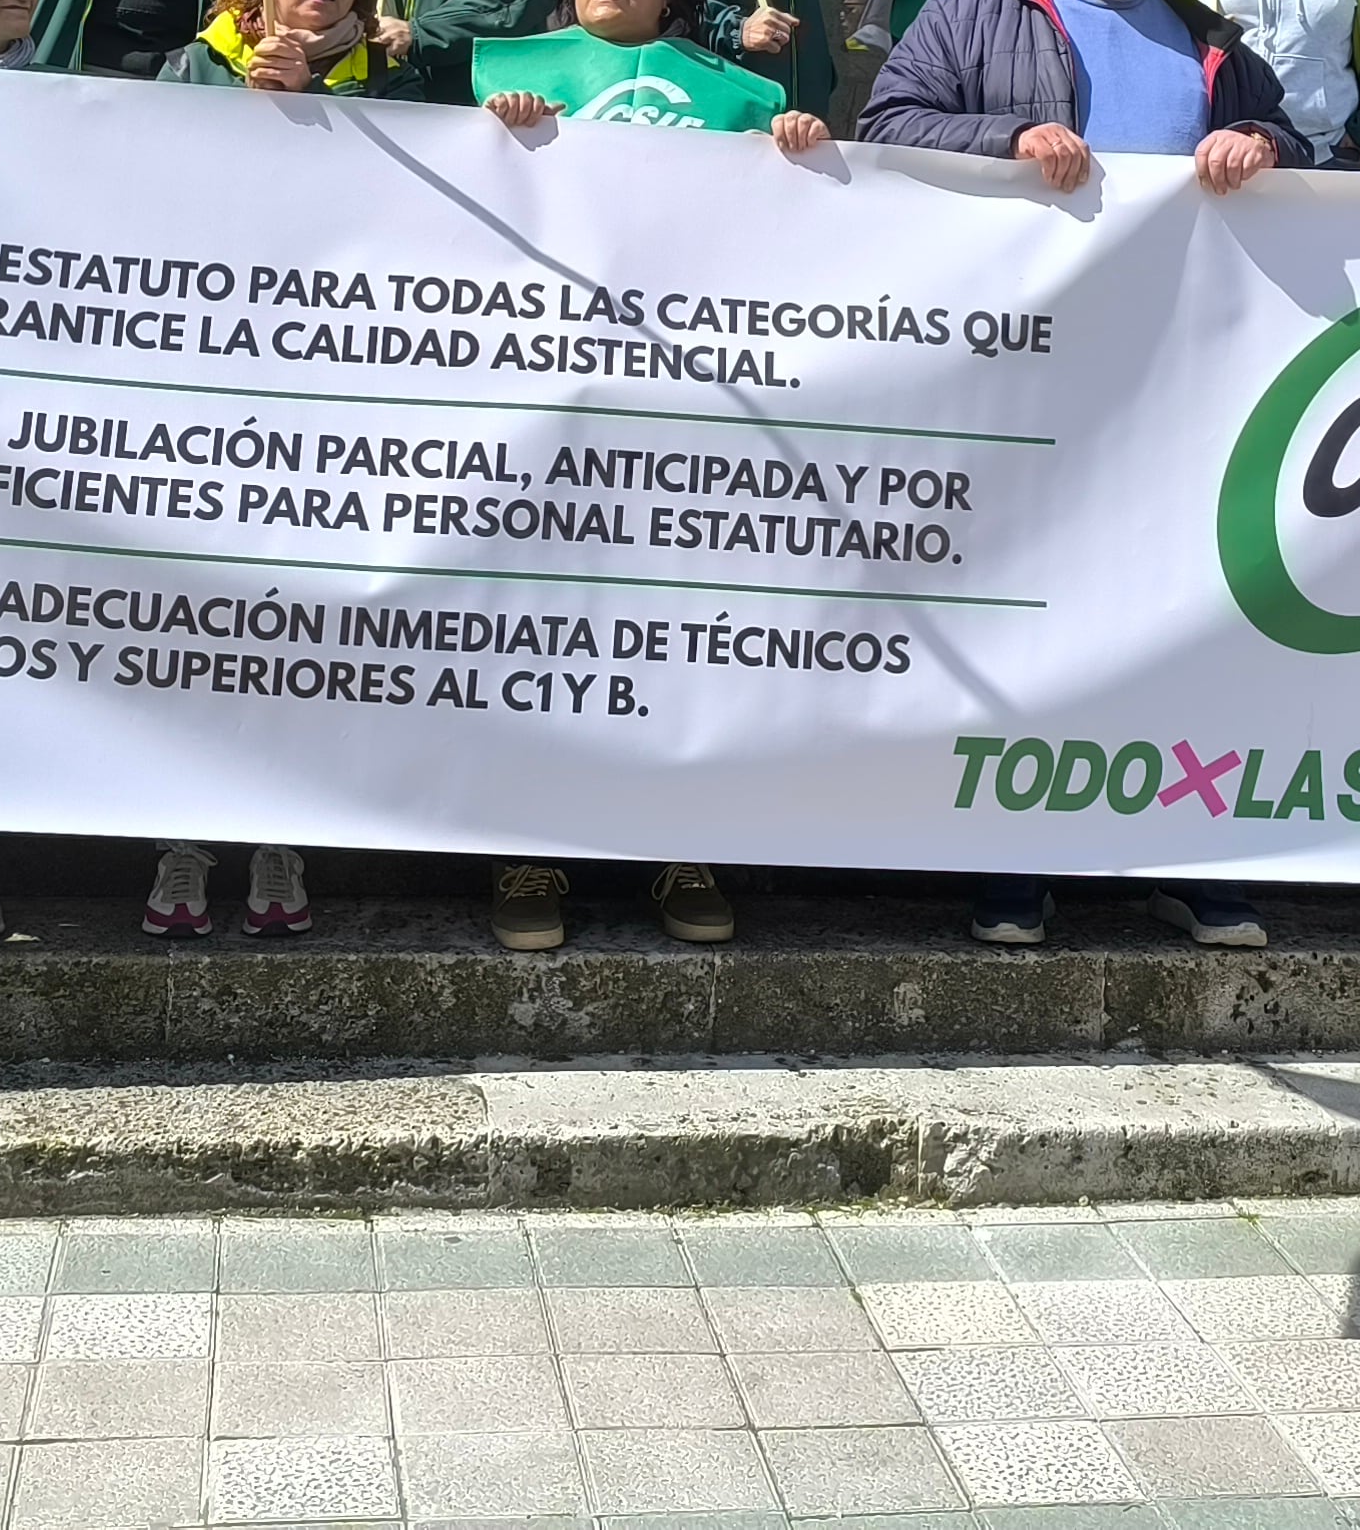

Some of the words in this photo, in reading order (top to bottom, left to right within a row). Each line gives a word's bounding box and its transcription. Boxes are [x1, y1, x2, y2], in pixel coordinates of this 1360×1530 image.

[248, 266, 377, 311] PARA
[388, 275, 546, 319] TODAS
[559, 284, 645, 327] LAS
[657, 293, 950, 345] CATEGORÍAS
[963, 311, 1053, 358] QUE
[198, 316, 260, 358] LA
[271, 321, 480, 368] CALIDAD
[490, 332, 801, 389] ASISTENCIAL.
[7, 411, 303, 472] JUBILACIÓN
[316, 434, 532, 492] PARCIAL,
[544, 446, 828, 503] ANTICIPADA
[835, 464, 870, 504] Y
[879, 467, 973, 511] POR
[238, 484, 370, 532] PARA
[383, 493, 635, 545] PERSONAL
[649, 507, 962, 565] ESTATUTARIO.
[67, 641, 105, 682] Y
[113, 645, 416, 705] SUPERIORES
[426, 667, 489, 710] AL
[501, 670, 553, 712] C1
[562, 673, 597, 714] Y
[607, 675, 649, 717] B.
[339, 606, 600, 658] INMEDIATA
[612, 619, 670, 662] DE
[680, 610, 910, 674] TÉCNICOS
